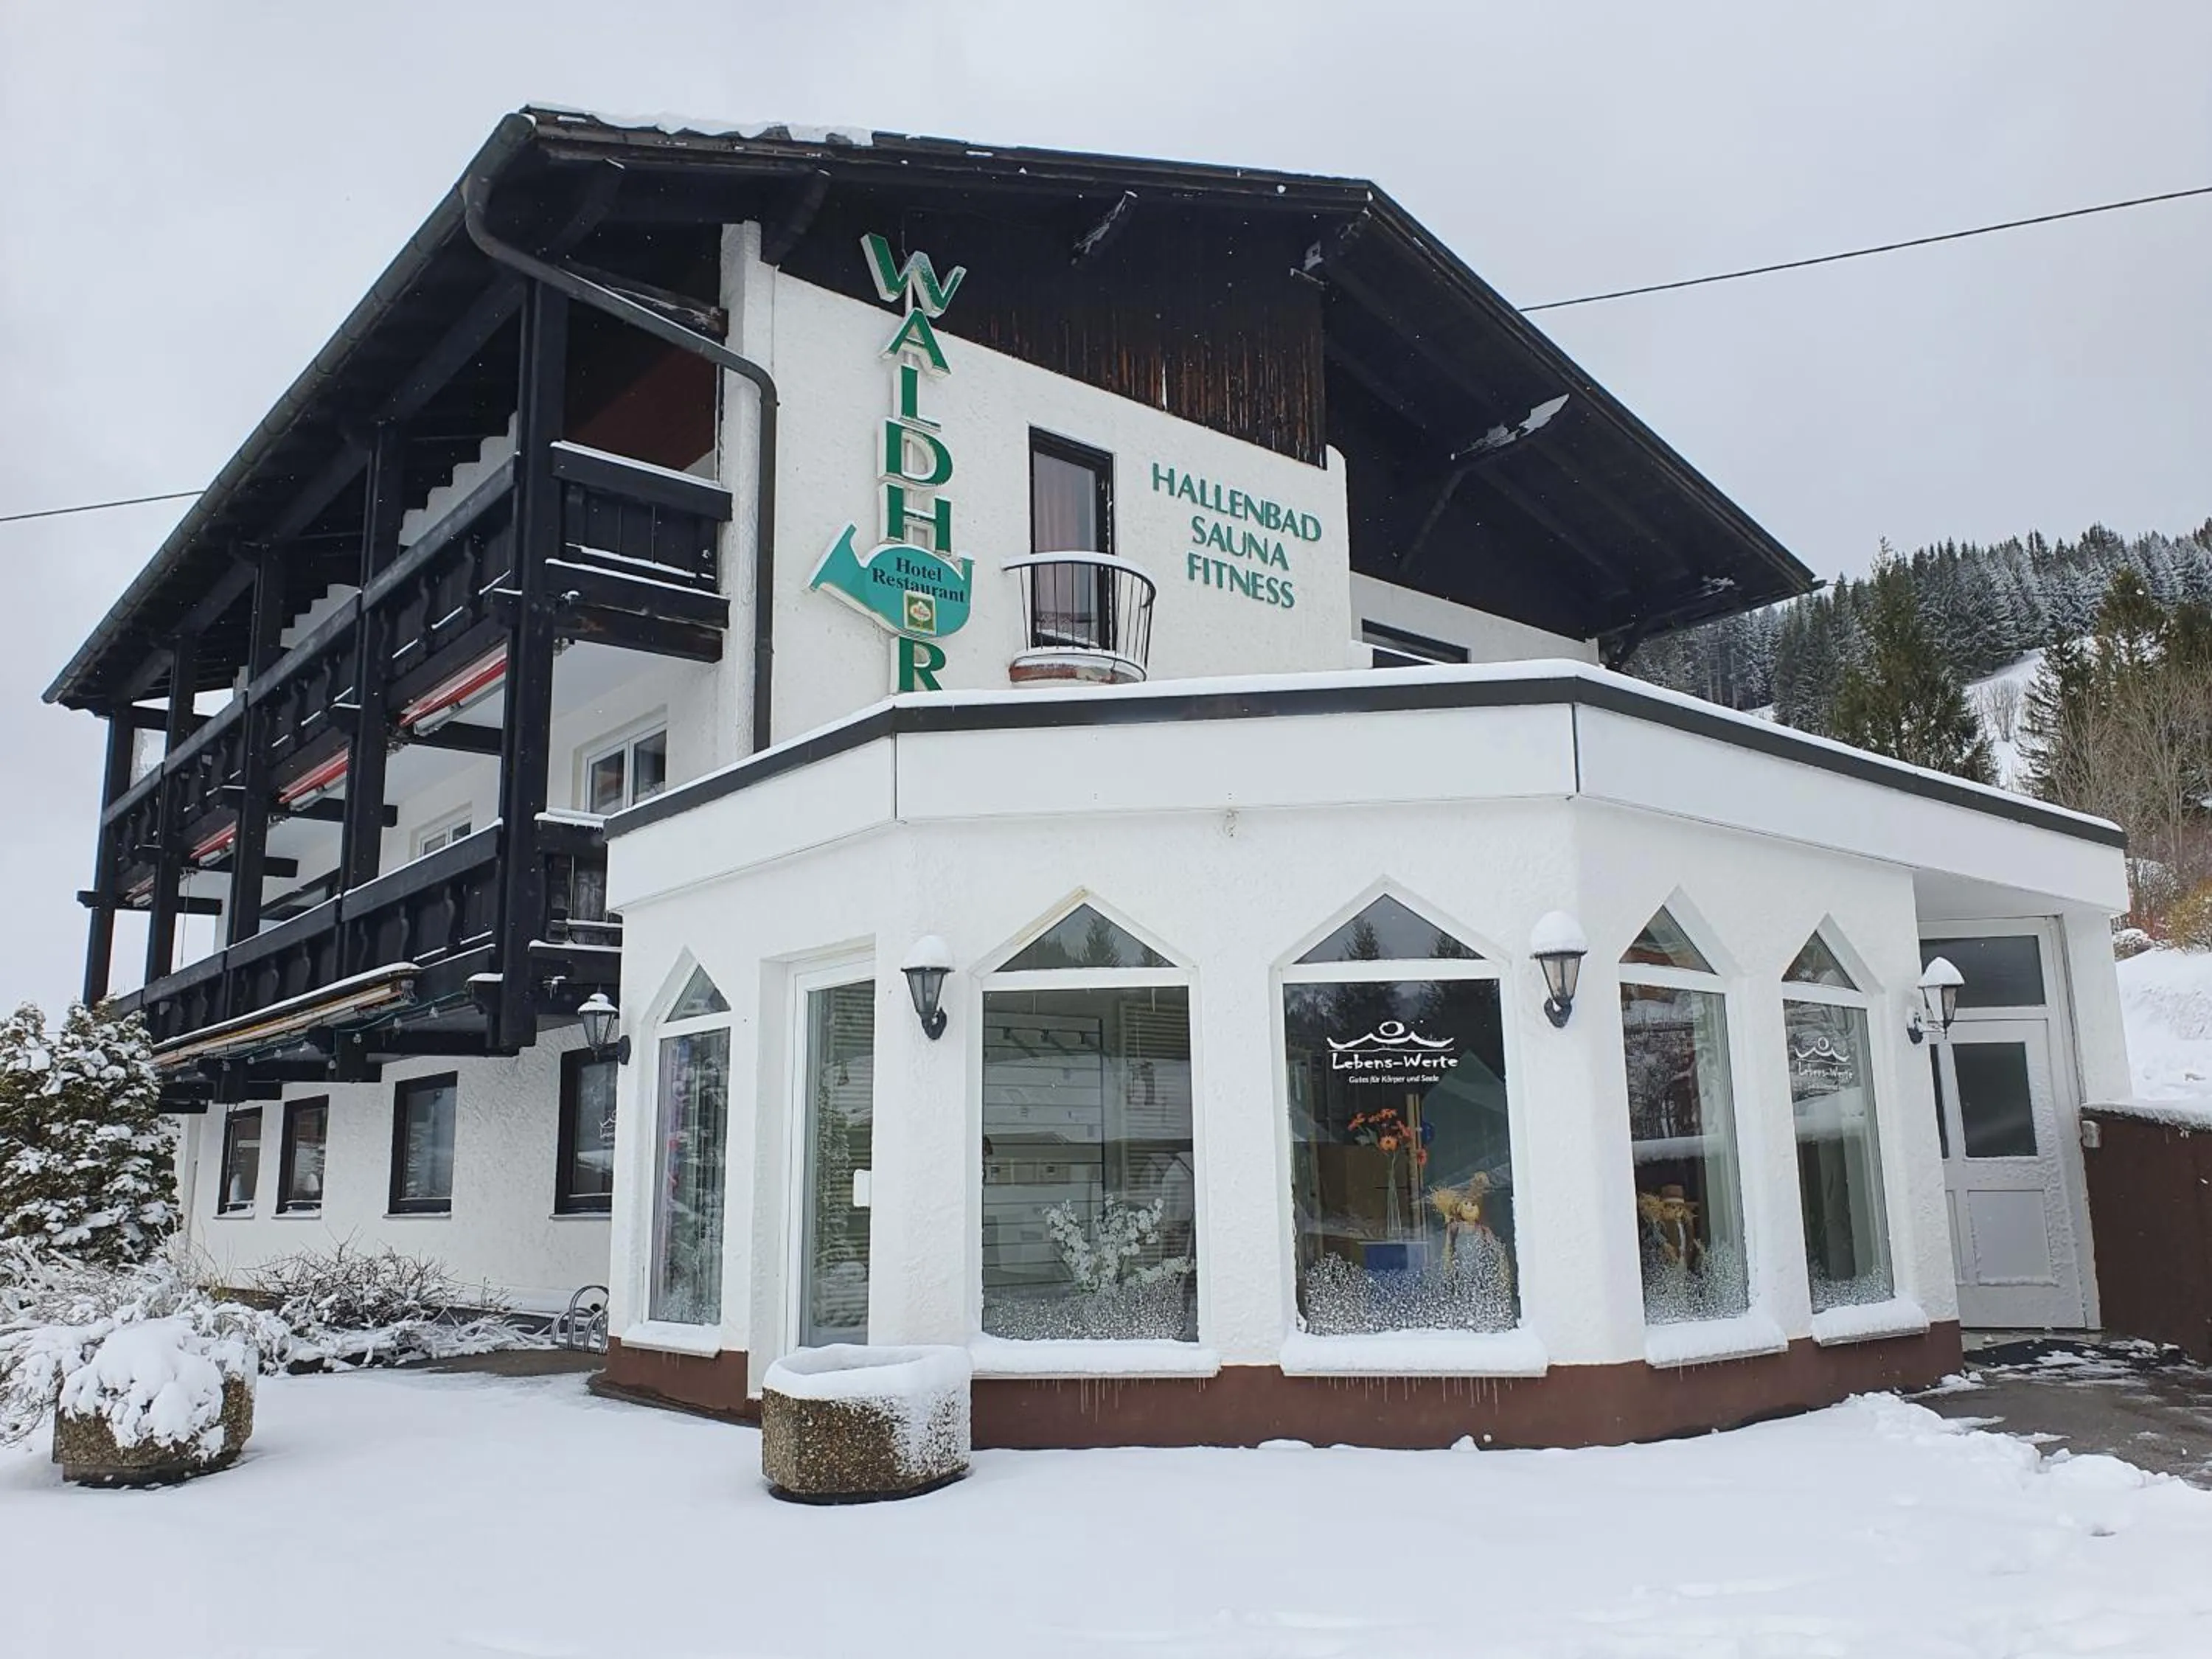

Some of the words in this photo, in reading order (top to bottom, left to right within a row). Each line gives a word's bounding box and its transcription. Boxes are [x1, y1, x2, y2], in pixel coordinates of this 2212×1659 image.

[1152, 462, 1322, 542] HALLENBAD
[1191, 515, 1290, 571] SAUNA
[872, 567, 964, 602] Restaurant
[896, 556, 942, 582] Hotel
[1188, 552, 1295, 608] FITNESS
[1332, 1052, 1458, 1070] Lebens-Werte
[1406, 1074, 1421, 1082] und
